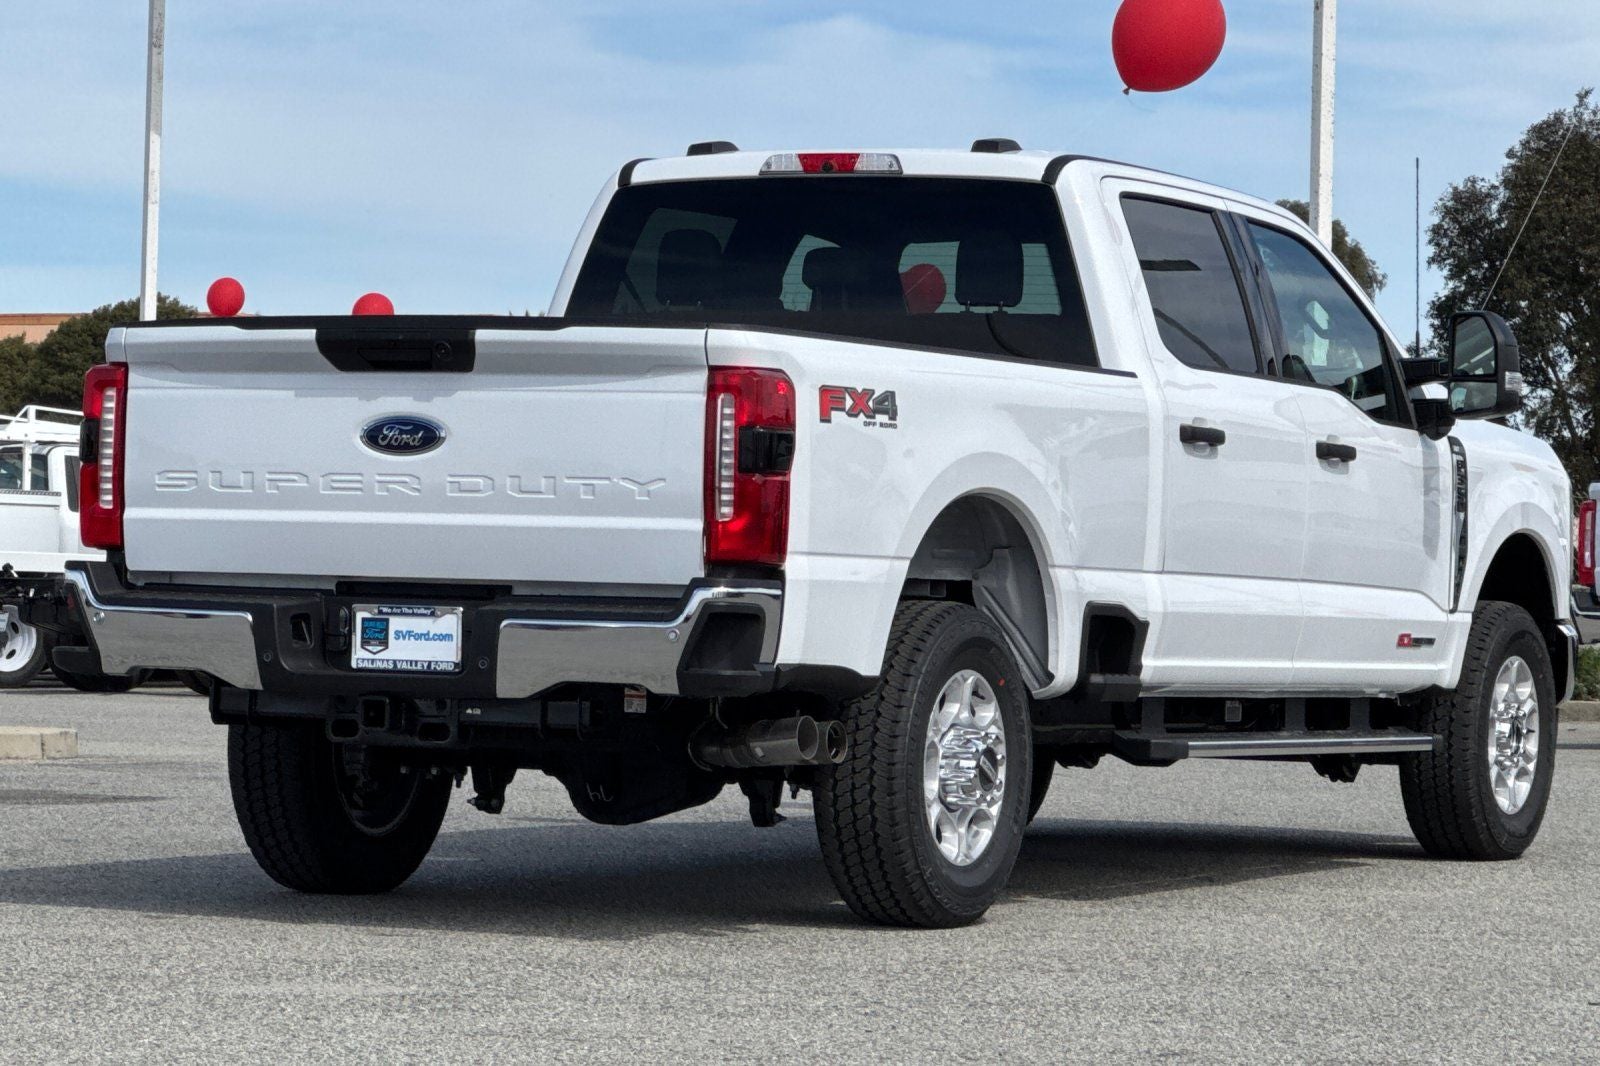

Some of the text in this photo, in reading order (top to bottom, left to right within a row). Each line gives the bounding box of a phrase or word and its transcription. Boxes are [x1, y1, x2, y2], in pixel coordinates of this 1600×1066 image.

[819, 384, 898, 423] FX4
[863, 420, 898, 429] OFF ROAD
[378, 423, 424, 446] Ford
[155, 470, 667, 500] SUPER DUTY
[394, 630, 453, 642] SVFord.com
[357, 659, 455, 671] SALINAS VALLEY FORD
